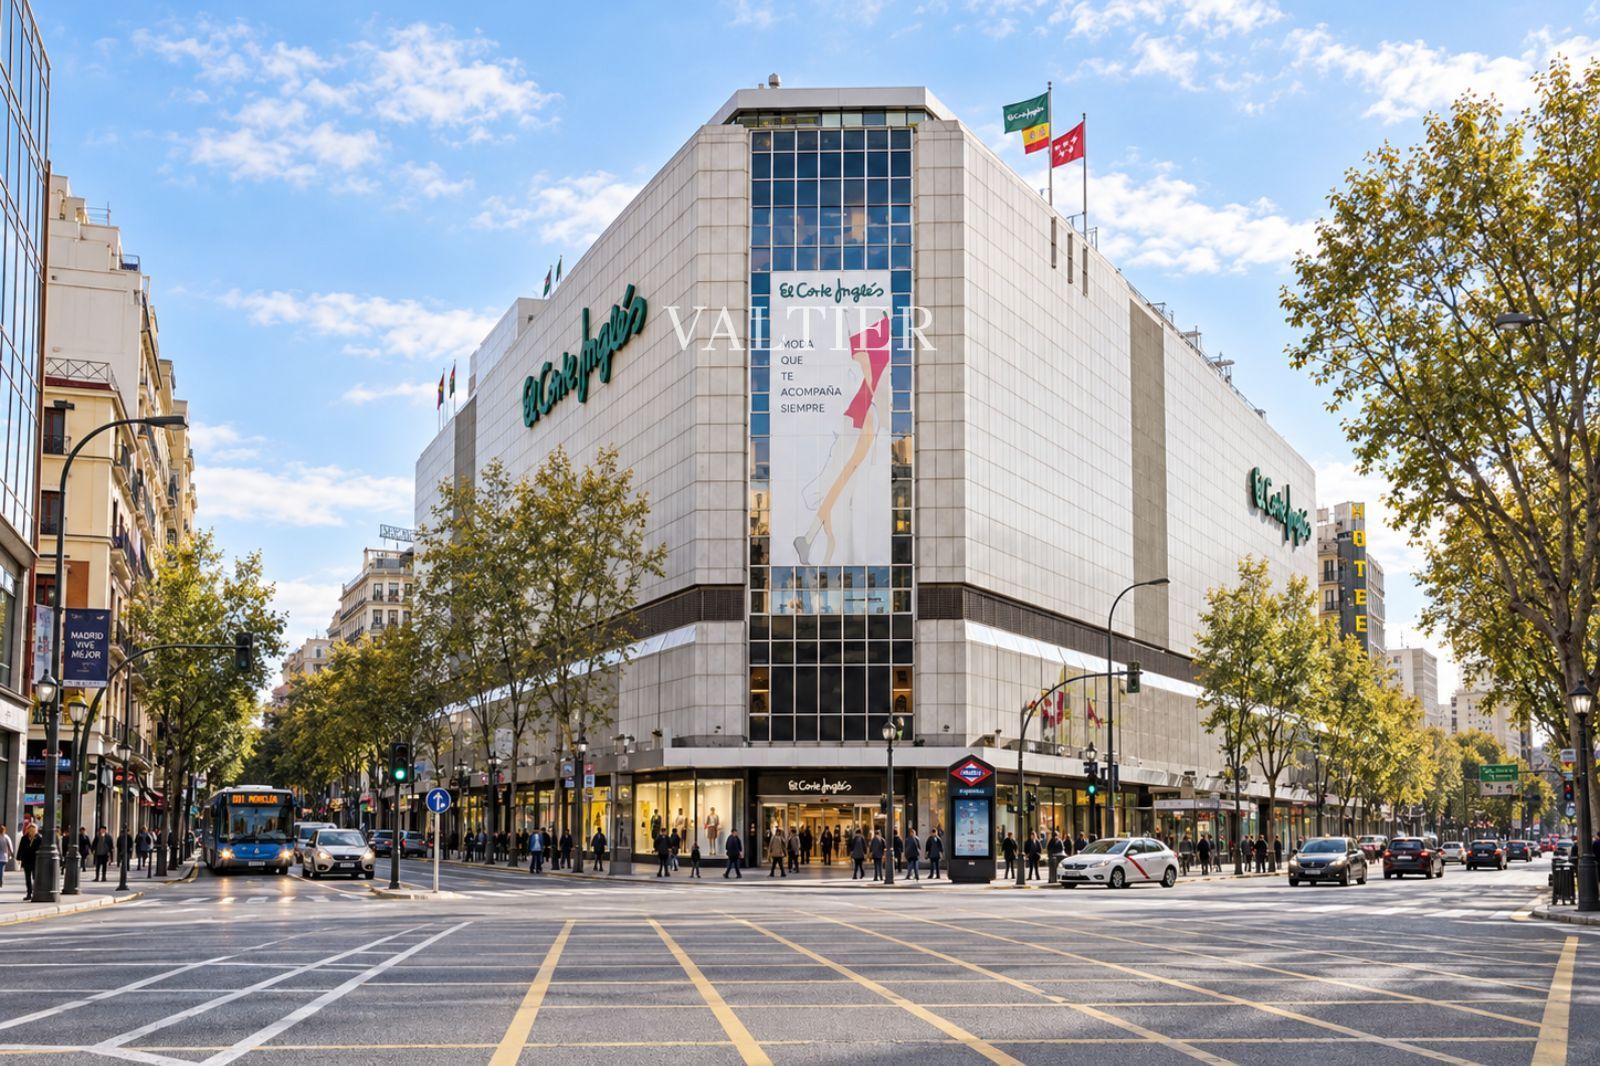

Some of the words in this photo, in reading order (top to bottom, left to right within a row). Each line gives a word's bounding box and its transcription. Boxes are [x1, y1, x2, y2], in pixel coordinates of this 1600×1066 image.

[779, 282, 793, 299] El
[796, 282, 832, 299] Corte
[834, 278, 884, 304] Inglés
[782, 339, 814, 349] MODA
[522, 375, 540, 429] El
[538, 351, 578, 416] Corte
[577, 283, 648, 404] Inglés
[781, 356, 803, 366] QUE
[781, 372, 794, 381] TE
[780, 385, 842, 397] ACOMPAÑA
[780, 403, 825, 413] SIEMPRE
[70, 631, 104, 640] MADRID
[75, 640, 95, 649] VIVE
